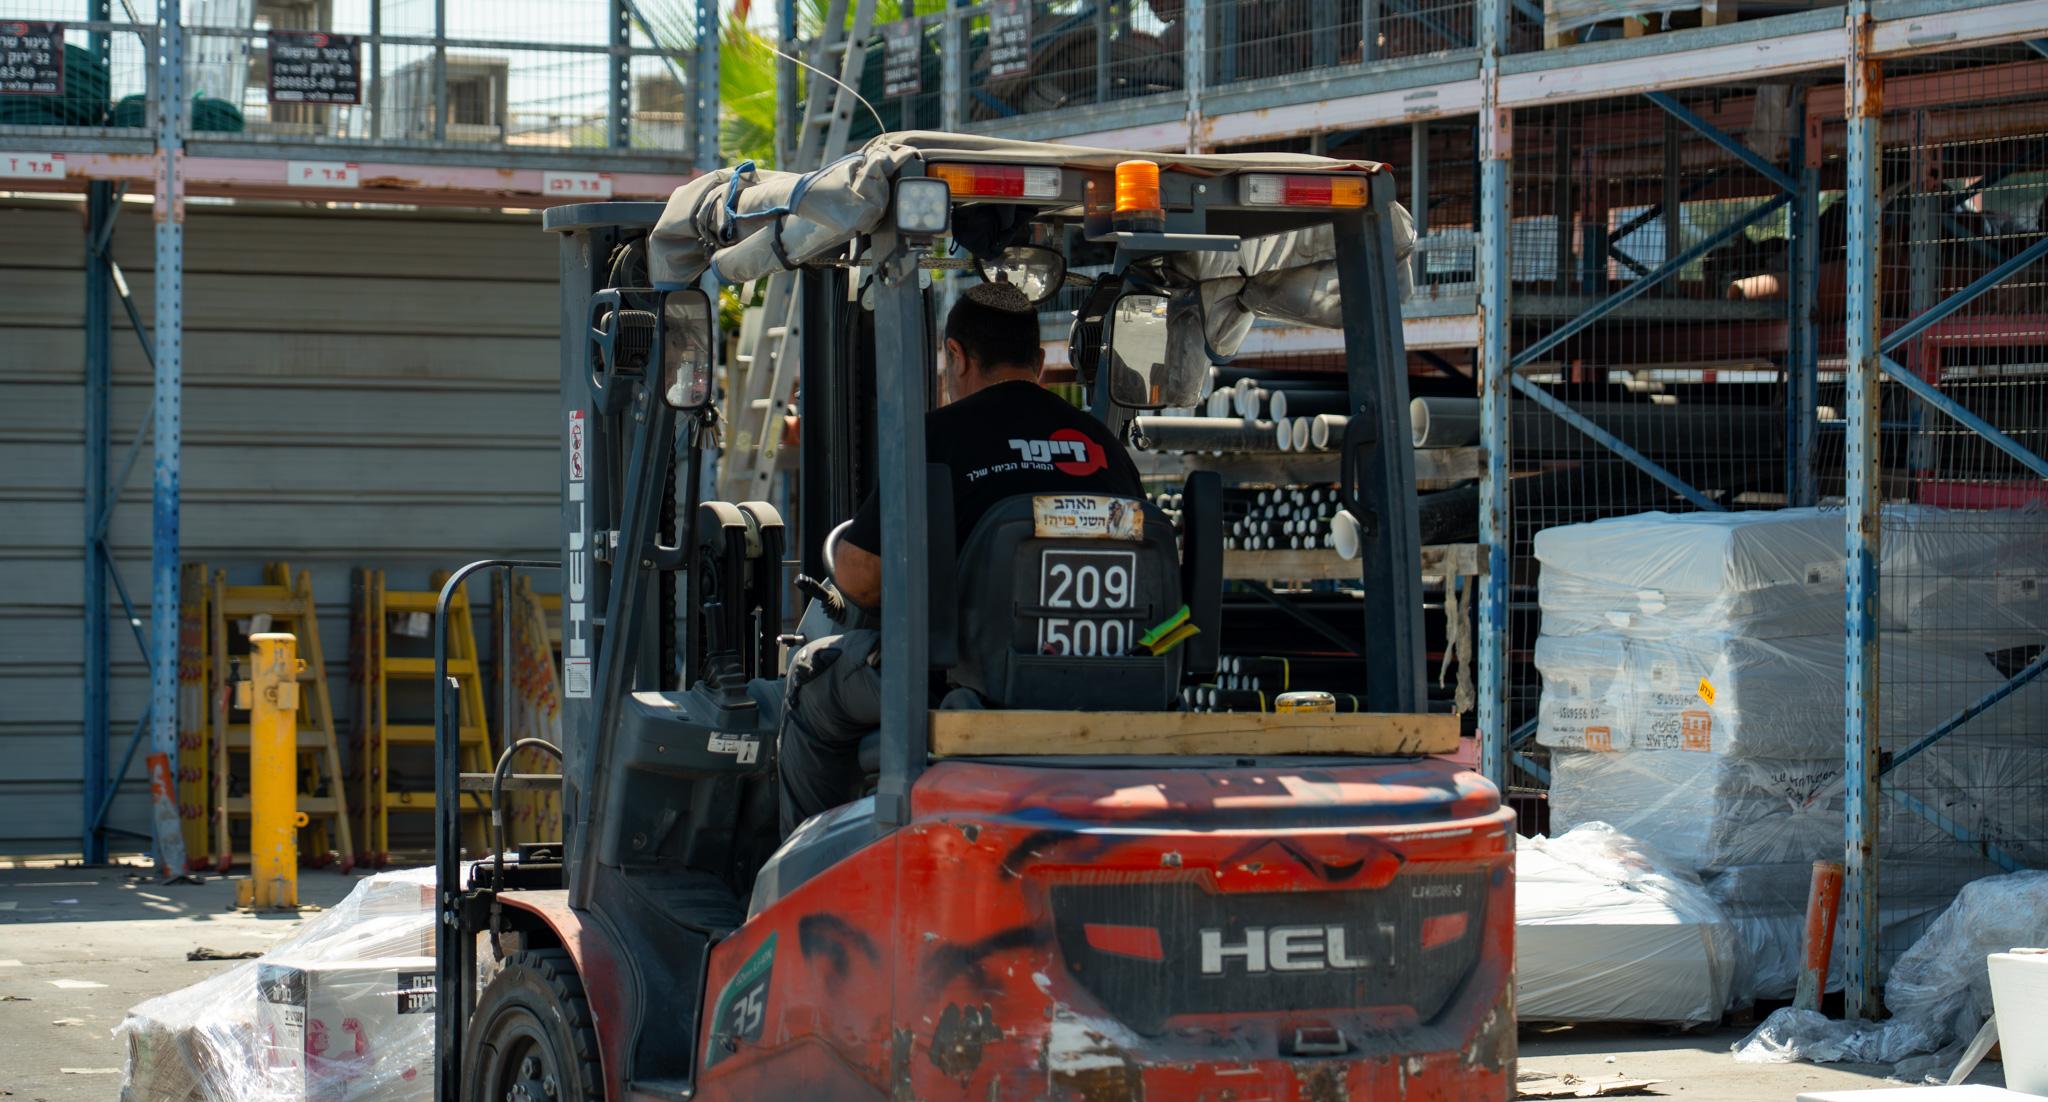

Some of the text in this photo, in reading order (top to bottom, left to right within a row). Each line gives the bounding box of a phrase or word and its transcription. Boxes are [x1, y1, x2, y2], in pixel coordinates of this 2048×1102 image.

[966, 461, 1054, 482] המגרש הביתי שלך
[1054, 497, 1096, 510] תאהב
[569, 482, 586, 657] HELI
[1048, 563, 1128, 609] 209
[1047, 619, 1124, 657] 500
